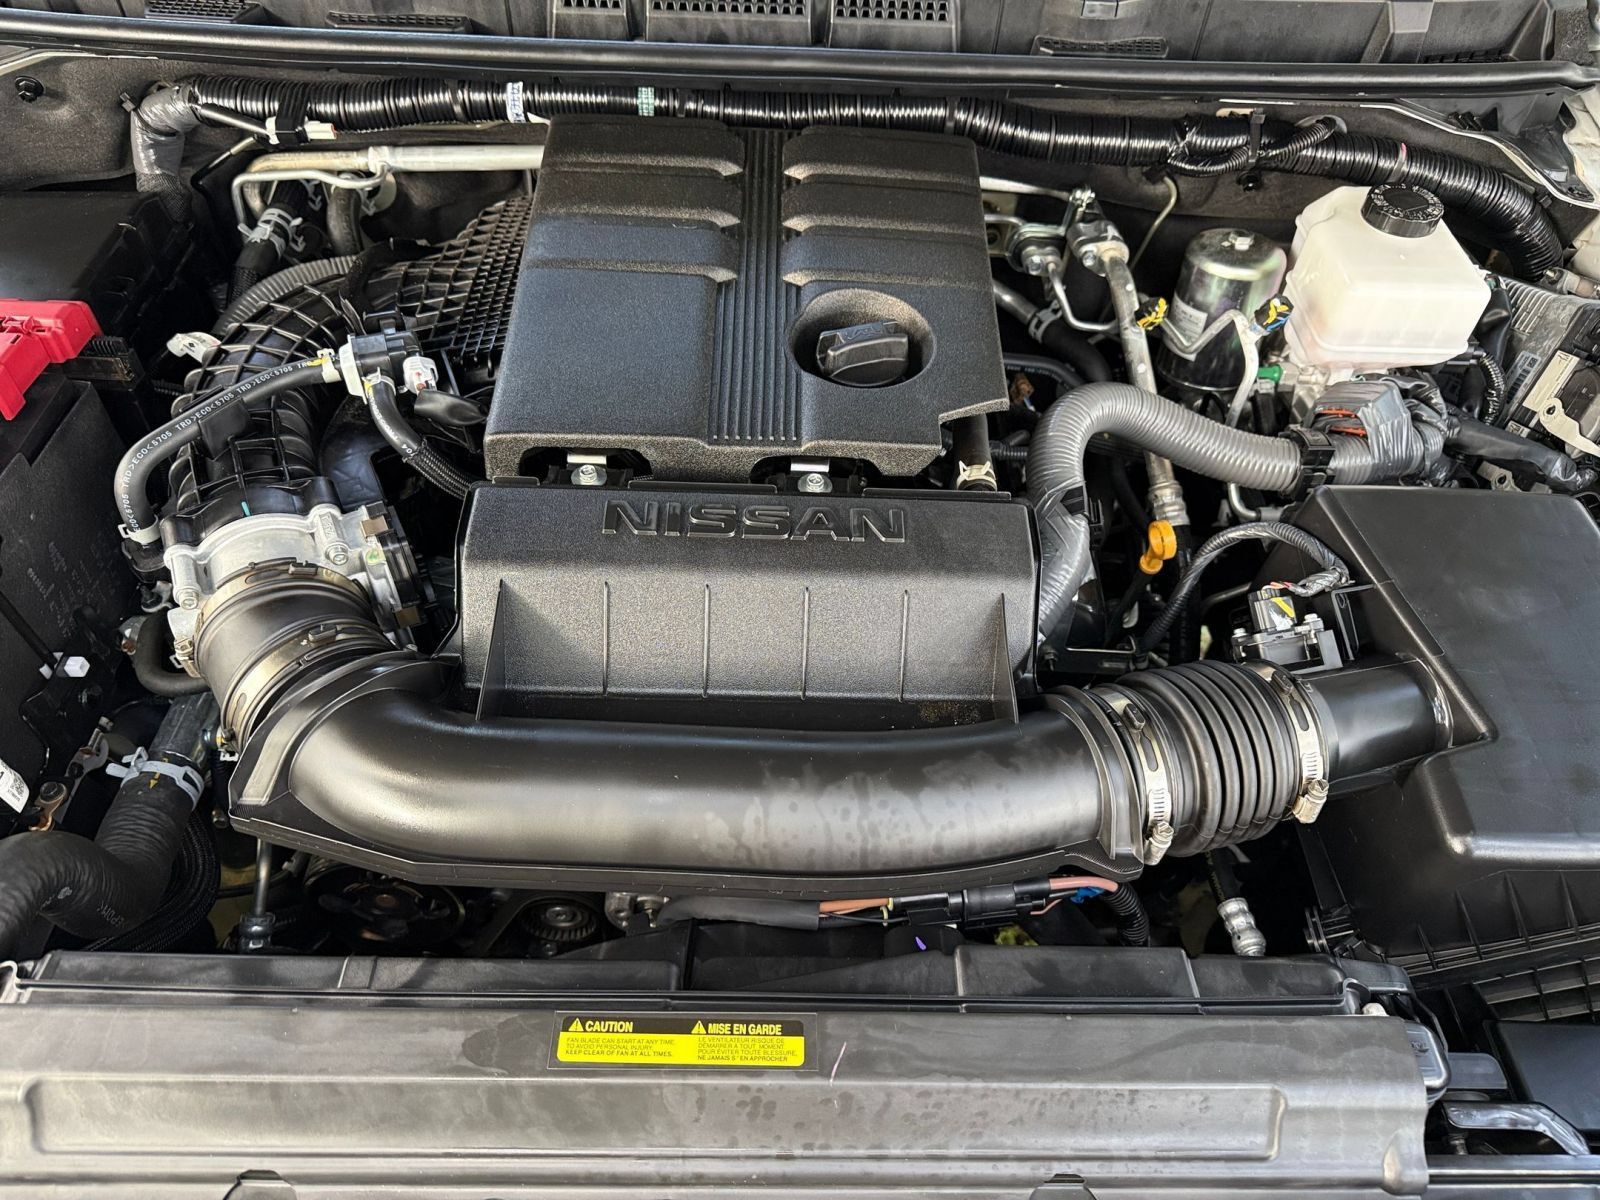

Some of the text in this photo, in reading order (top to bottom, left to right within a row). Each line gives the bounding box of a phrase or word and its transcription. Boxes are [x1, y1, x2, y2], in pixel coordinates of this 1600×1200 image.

[602, 500, 905, 543] NISSAN
[585, 1021, 634, 1032] CAUTION
[708, 1023, 782, 1035] MISE EN GARDE
